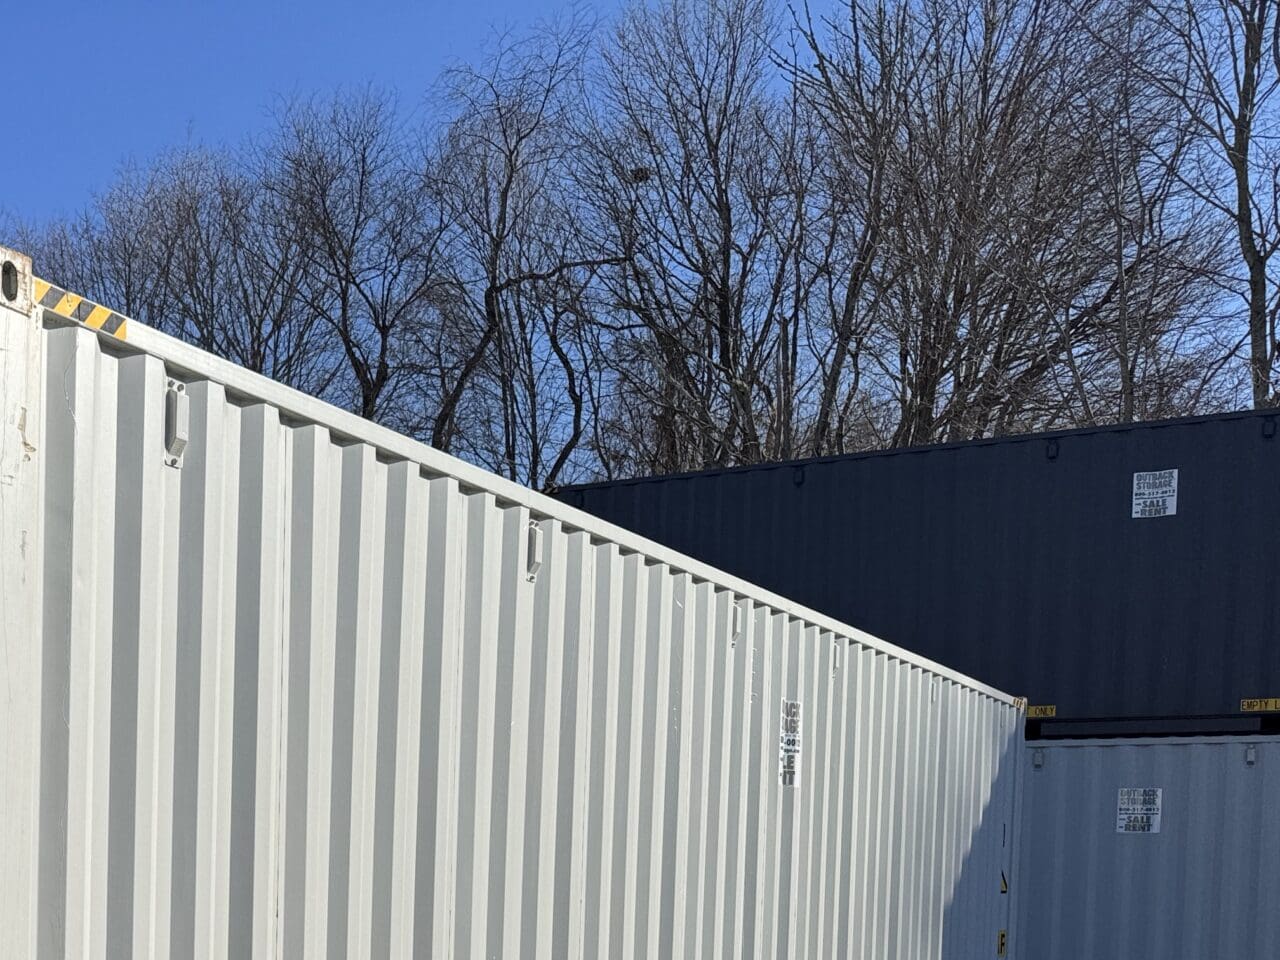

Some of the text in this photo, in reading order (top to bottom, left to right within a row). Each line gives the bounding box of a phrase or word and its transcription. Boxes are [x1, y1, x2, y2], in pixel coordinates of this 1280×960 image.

[1136, 471, 1174, 481] OUTBACK
[1136, 479, 1173, 490] STORAGE
[1142, 499, 1167, 508] SALE
[1140, 507, 1168, 516] RENT
[1242, 700, 1269, 710] EMPTY
